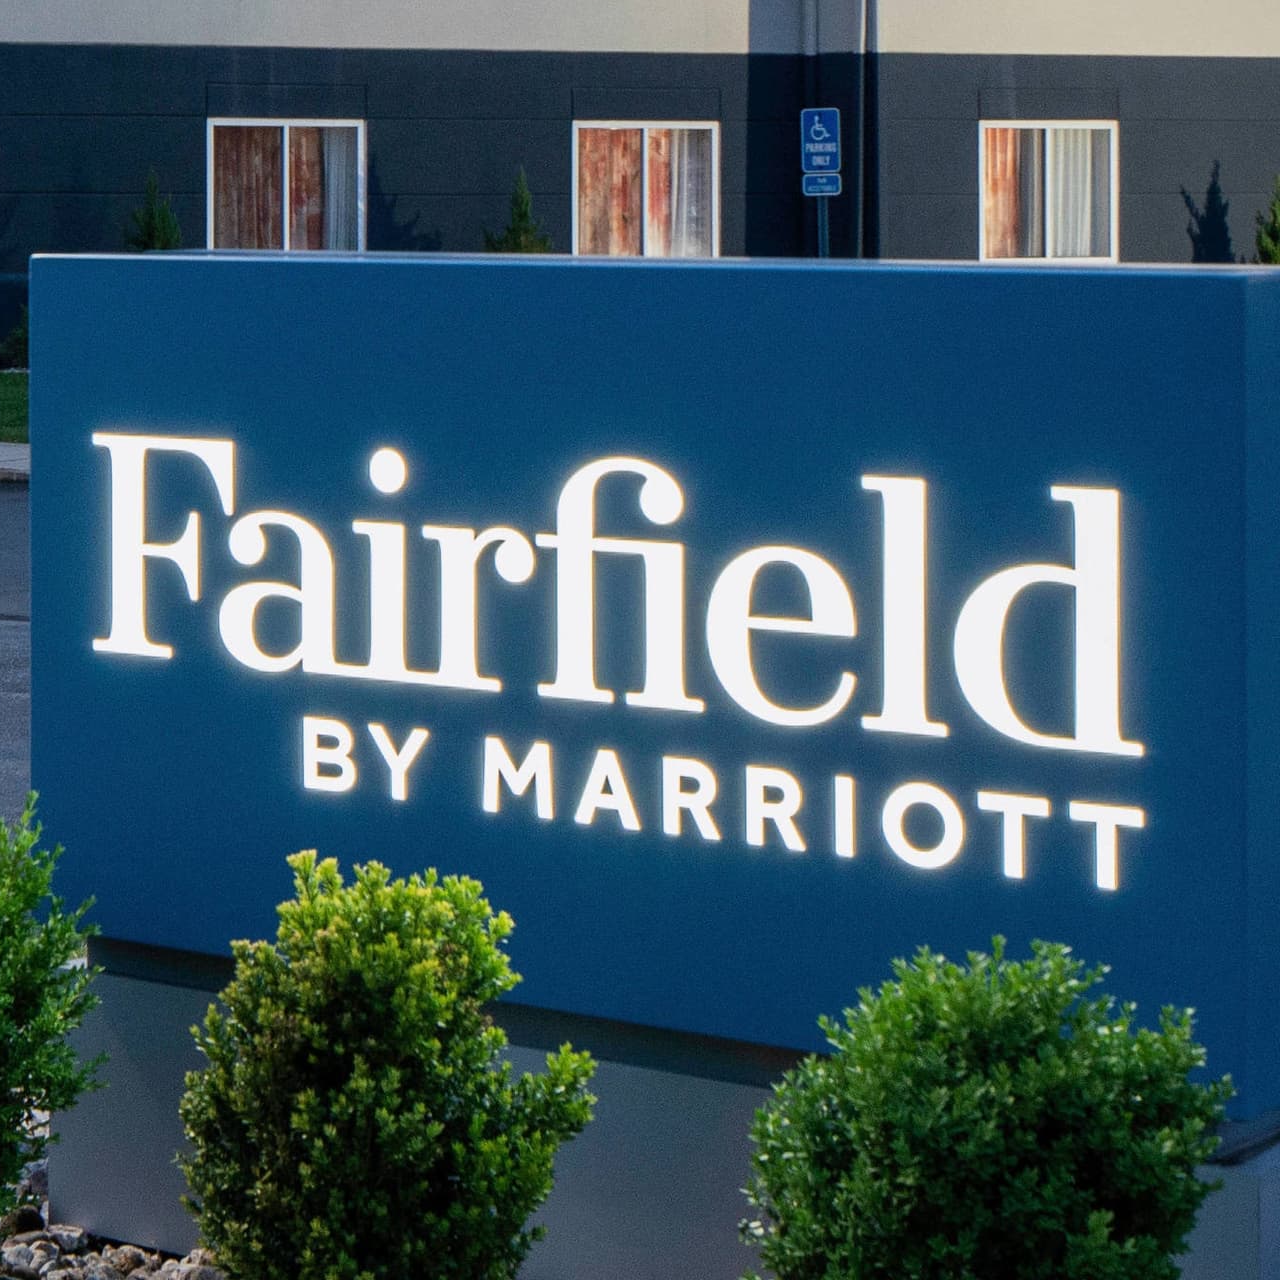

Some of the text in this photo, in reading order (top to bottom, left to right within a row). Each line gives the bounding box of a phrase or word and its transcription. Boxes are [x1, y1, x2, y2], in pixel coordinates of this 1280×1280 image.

[805, 142, 837, 153] PARKING
[812, 155, 831, 166] ONLY
[92, 431, 1145, 759] Fairfield
[300, 715, 1146, 892] BY MARRIOTT
